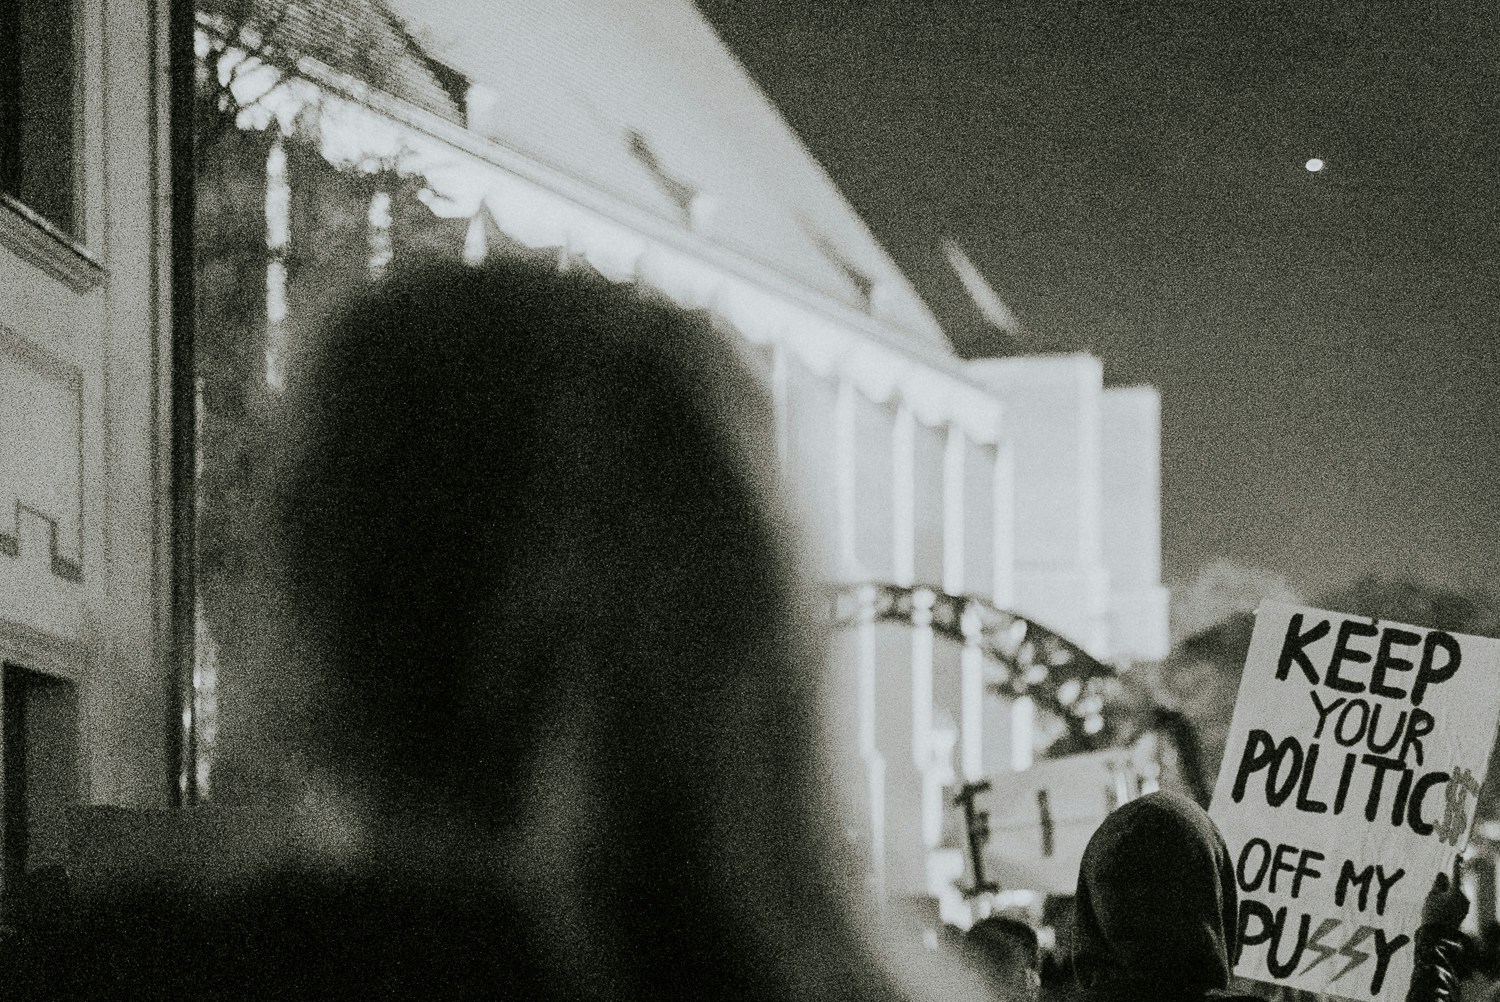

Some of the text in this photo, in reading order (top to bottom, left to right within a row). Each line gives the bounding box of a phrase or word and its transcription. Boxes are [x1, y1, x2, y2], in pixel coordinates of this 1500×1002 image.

[1275, 613, 1462, 706] KEEP
[1310, 690, 1435, 766] YOUR
[1236, 837, 1405, 915] OFF MY
